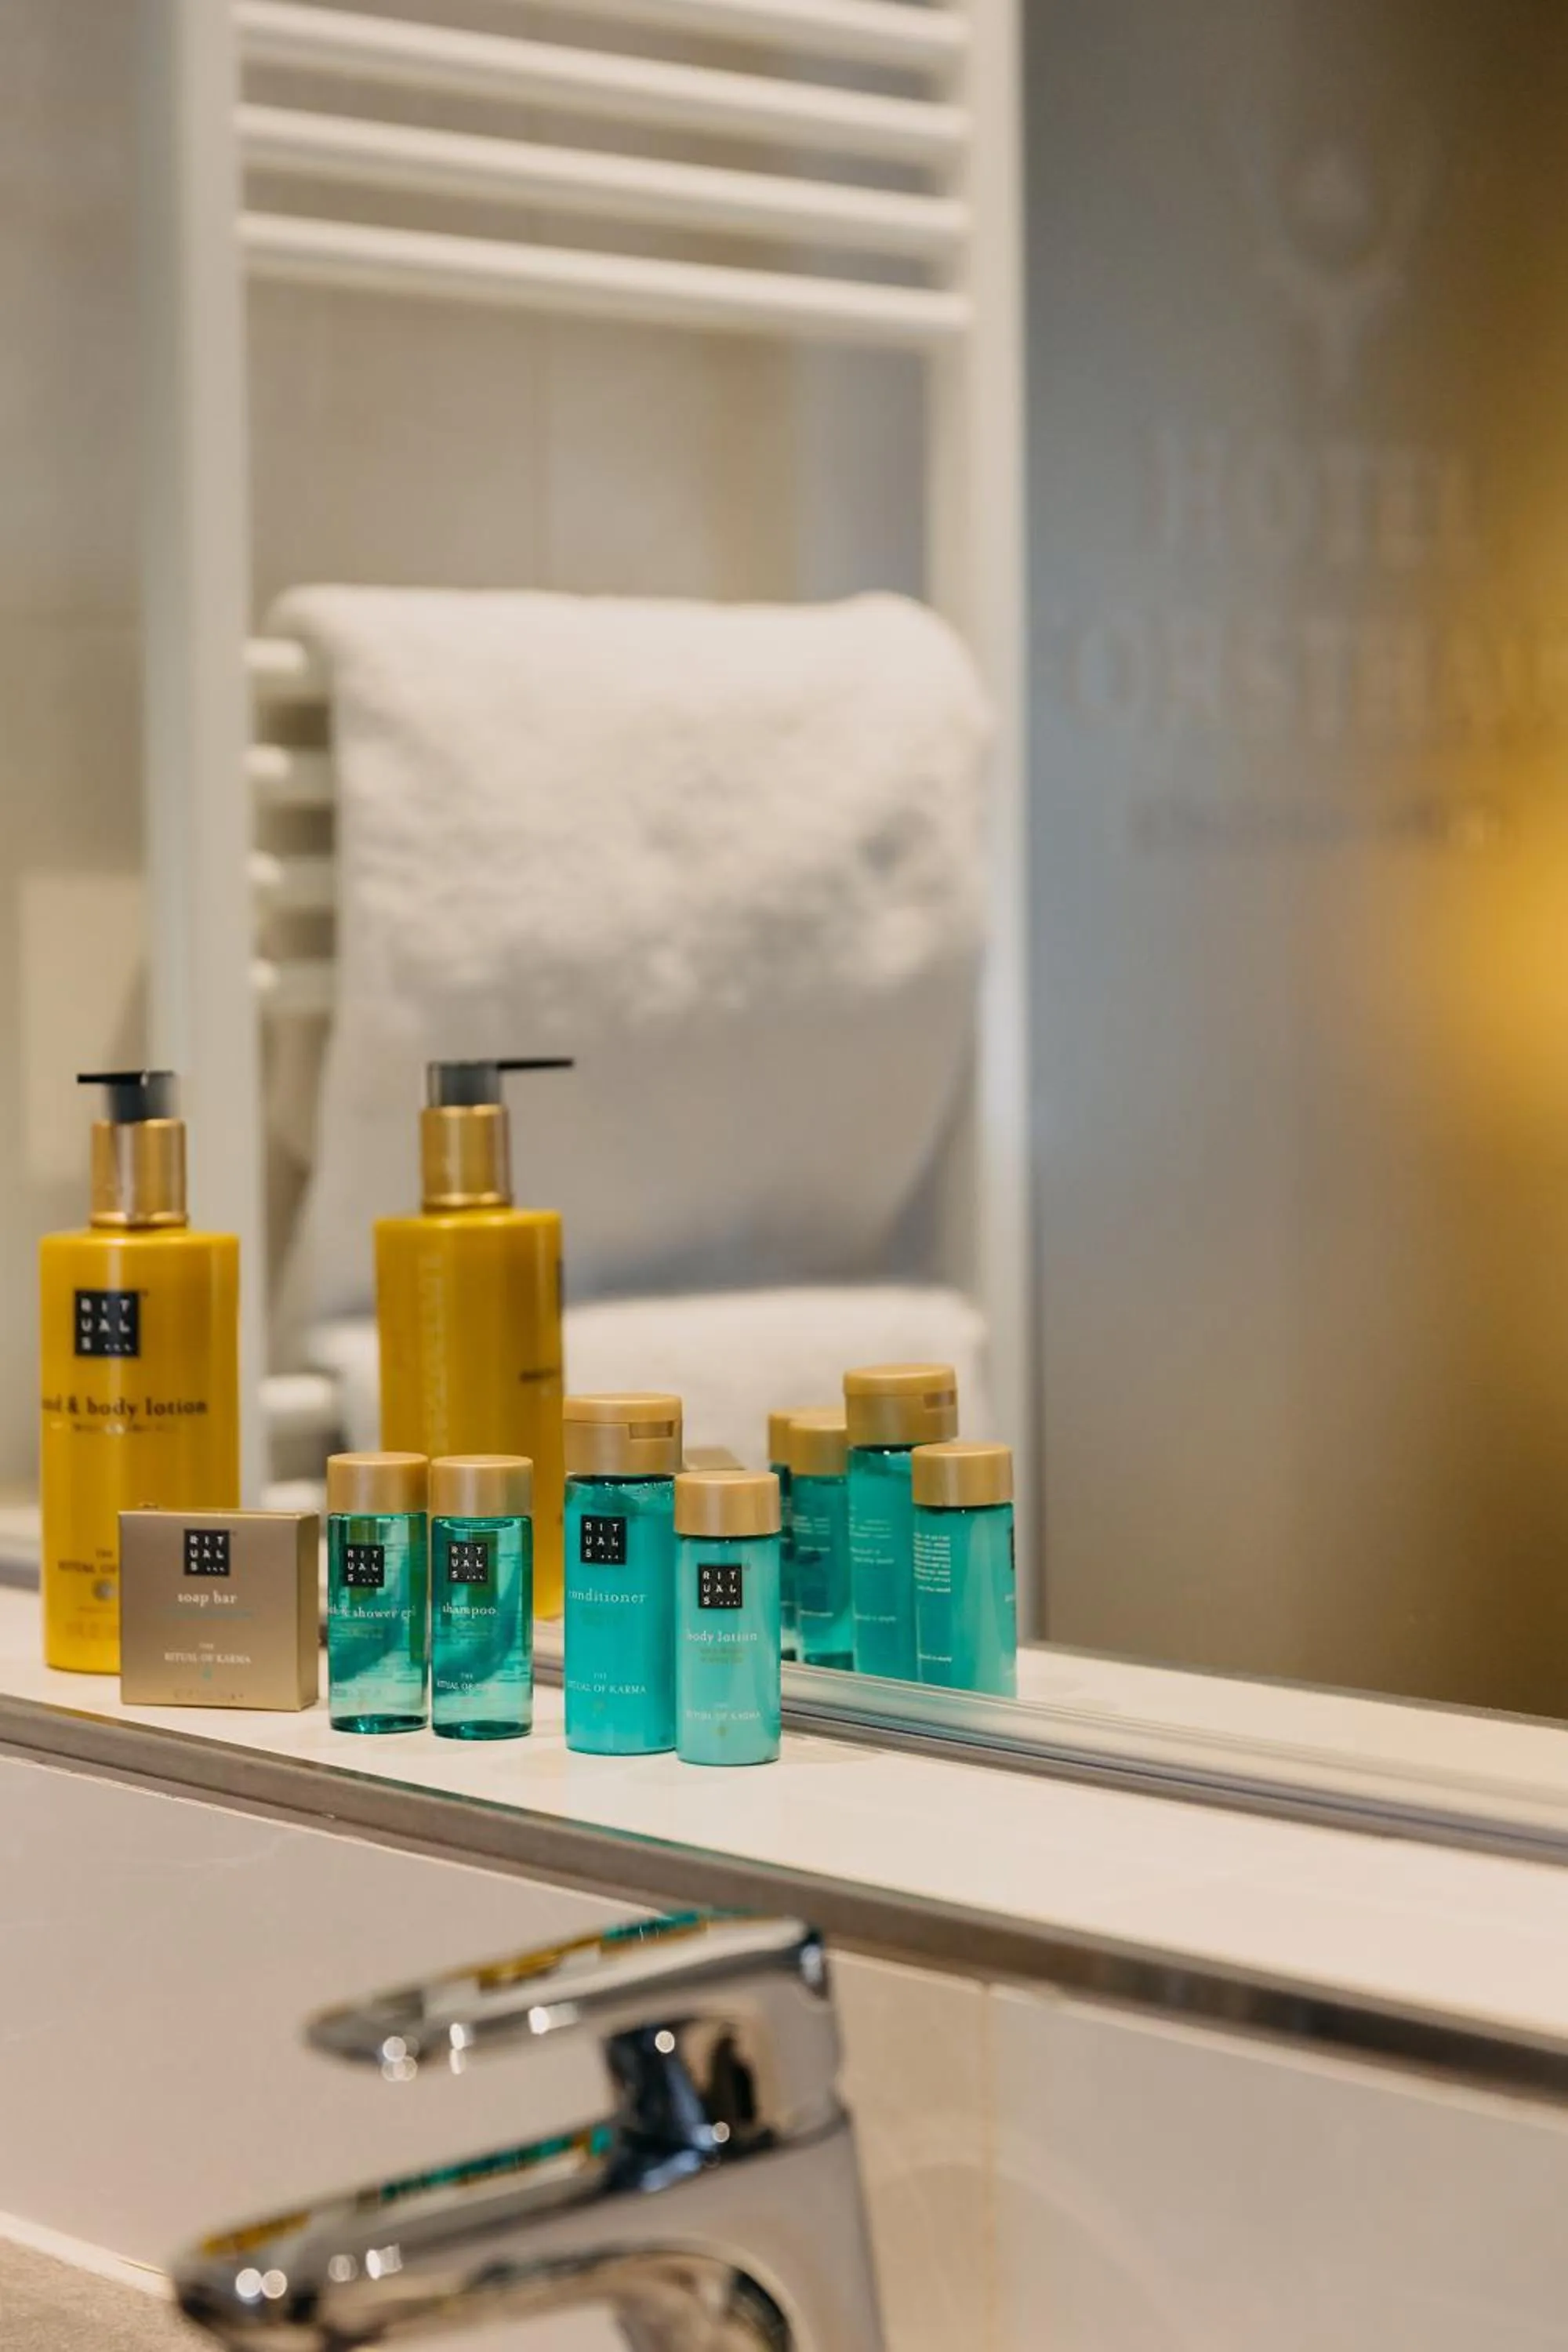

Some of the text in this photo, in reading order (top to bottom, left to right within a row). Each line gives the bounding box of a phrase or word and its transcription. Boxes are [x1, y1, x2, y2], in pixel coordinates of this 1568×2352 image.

[86, 1396, 136, 1421] body
[145, 1396, 208, 1417] lotion
[177, 1590, 238, 1606] soap bar
[353, 1606, 397, 1619] shower
[442, 1602, 496, 1618] shampoo
[593, 1684, 605, 1693] OF
[608, 1685, 648, 1695] KARMA
